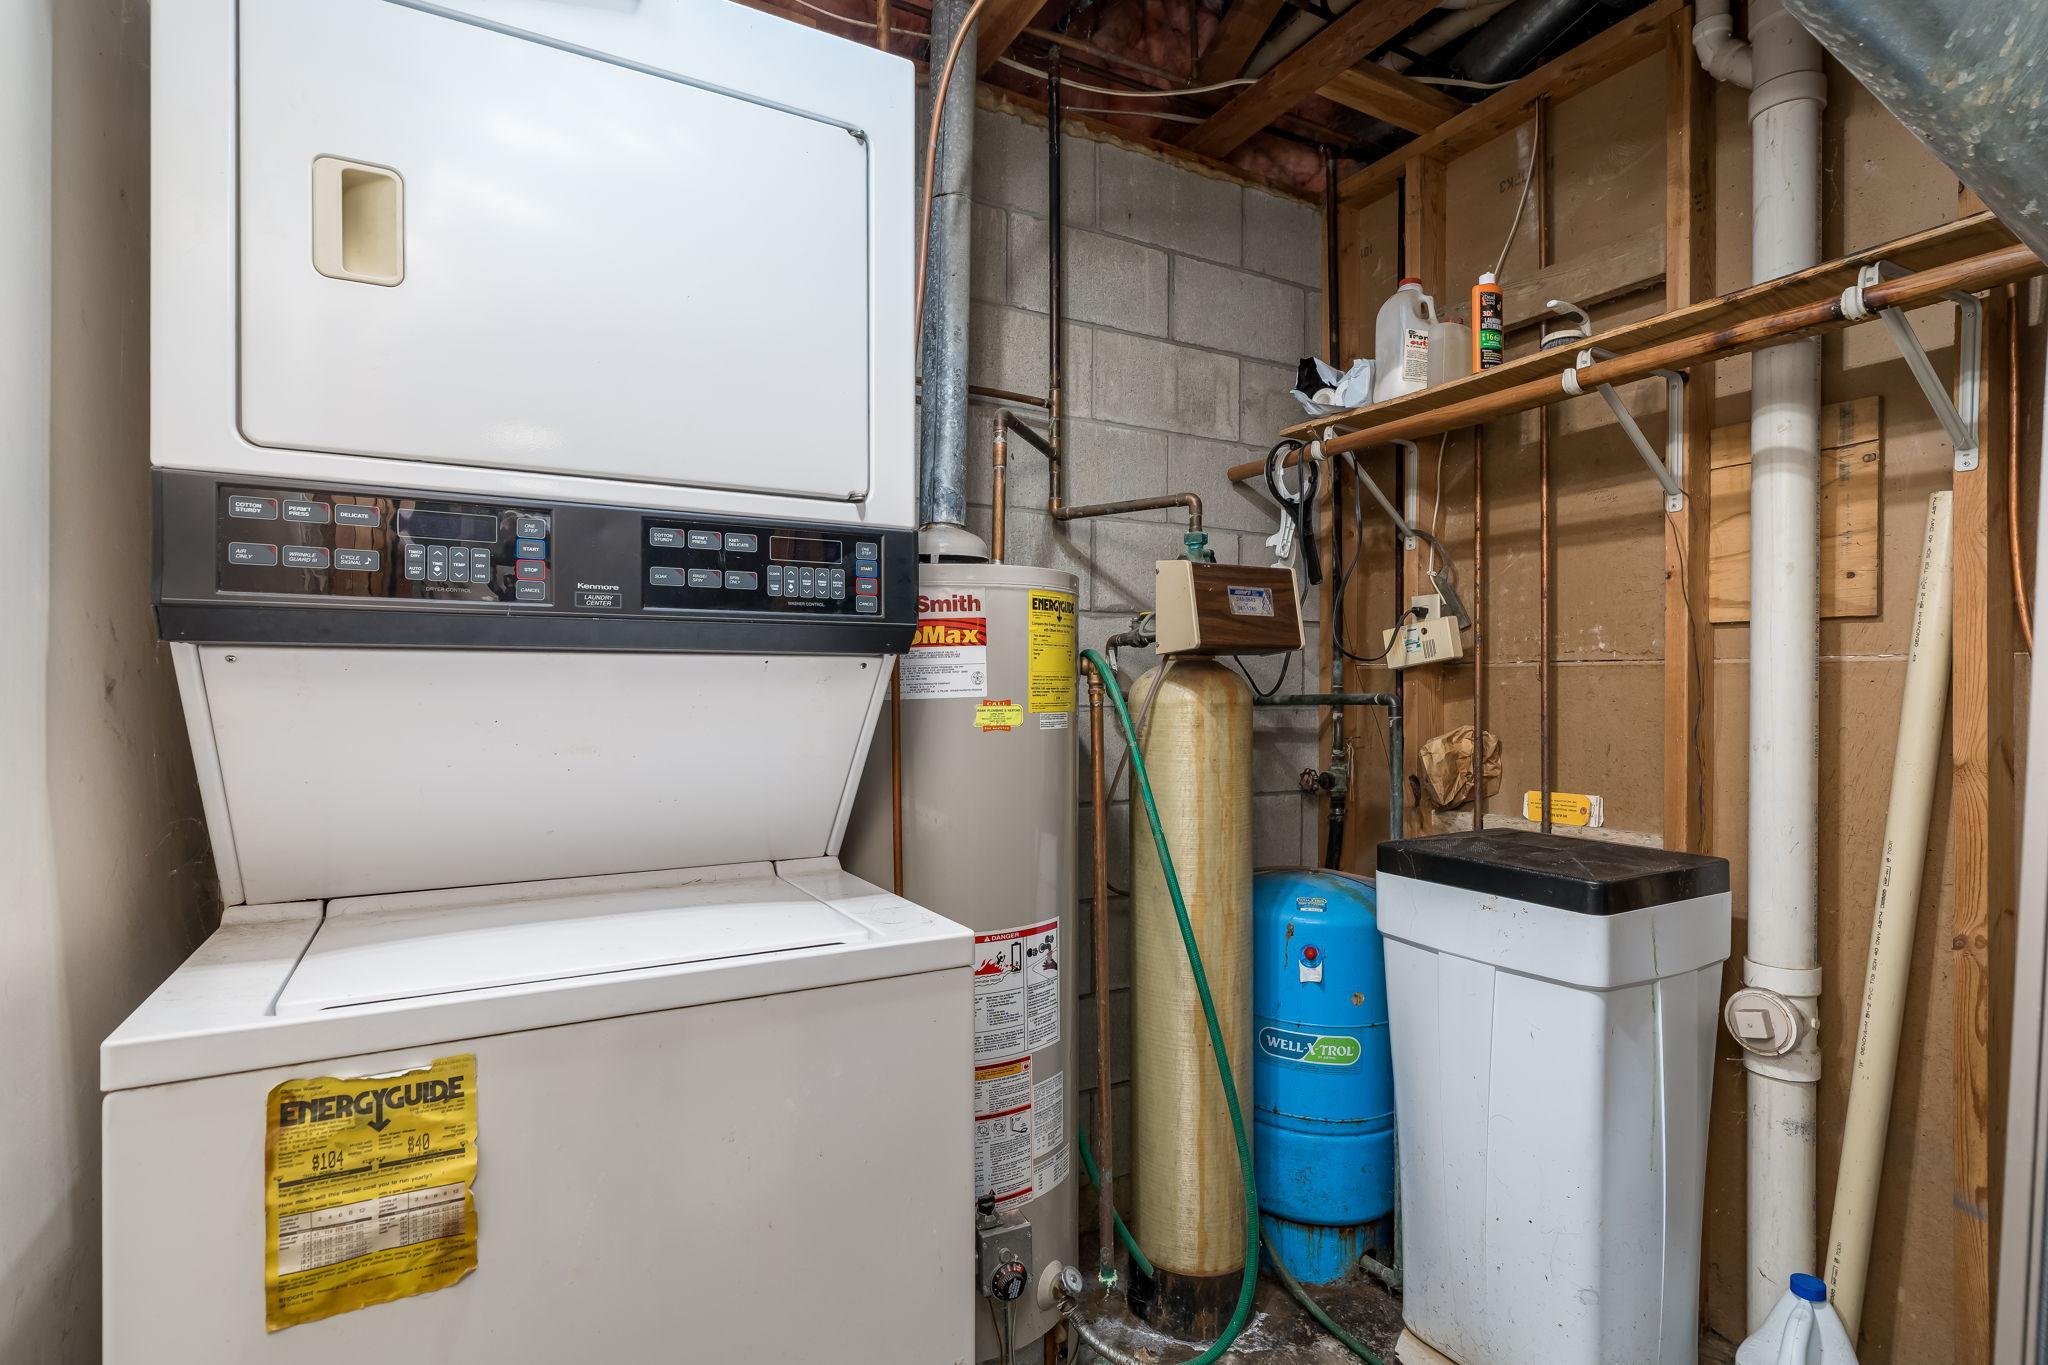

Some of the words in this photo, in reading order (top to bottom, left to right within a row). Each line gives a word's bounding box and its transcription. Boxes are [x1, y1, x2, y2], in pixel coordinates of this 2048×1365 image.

[235, 506, 262, 514] STURDY
[578, 582, 619, 590] Kenmore
[918, 594, 981, 613] Smith
[992, 932, 1020, 941] DANGER
[280, 1075, 465, 1127] ENERGYGUIDE
[408, 1132, 430, 1153] $40
[312, 1149, 344, 1171] $104
[278, 1200, 293, 1208] How
[295, 1196, 313, 1204] much
[342, 1186, 361, 1194] model
[411, 1173, 432, 1182] yearly?
